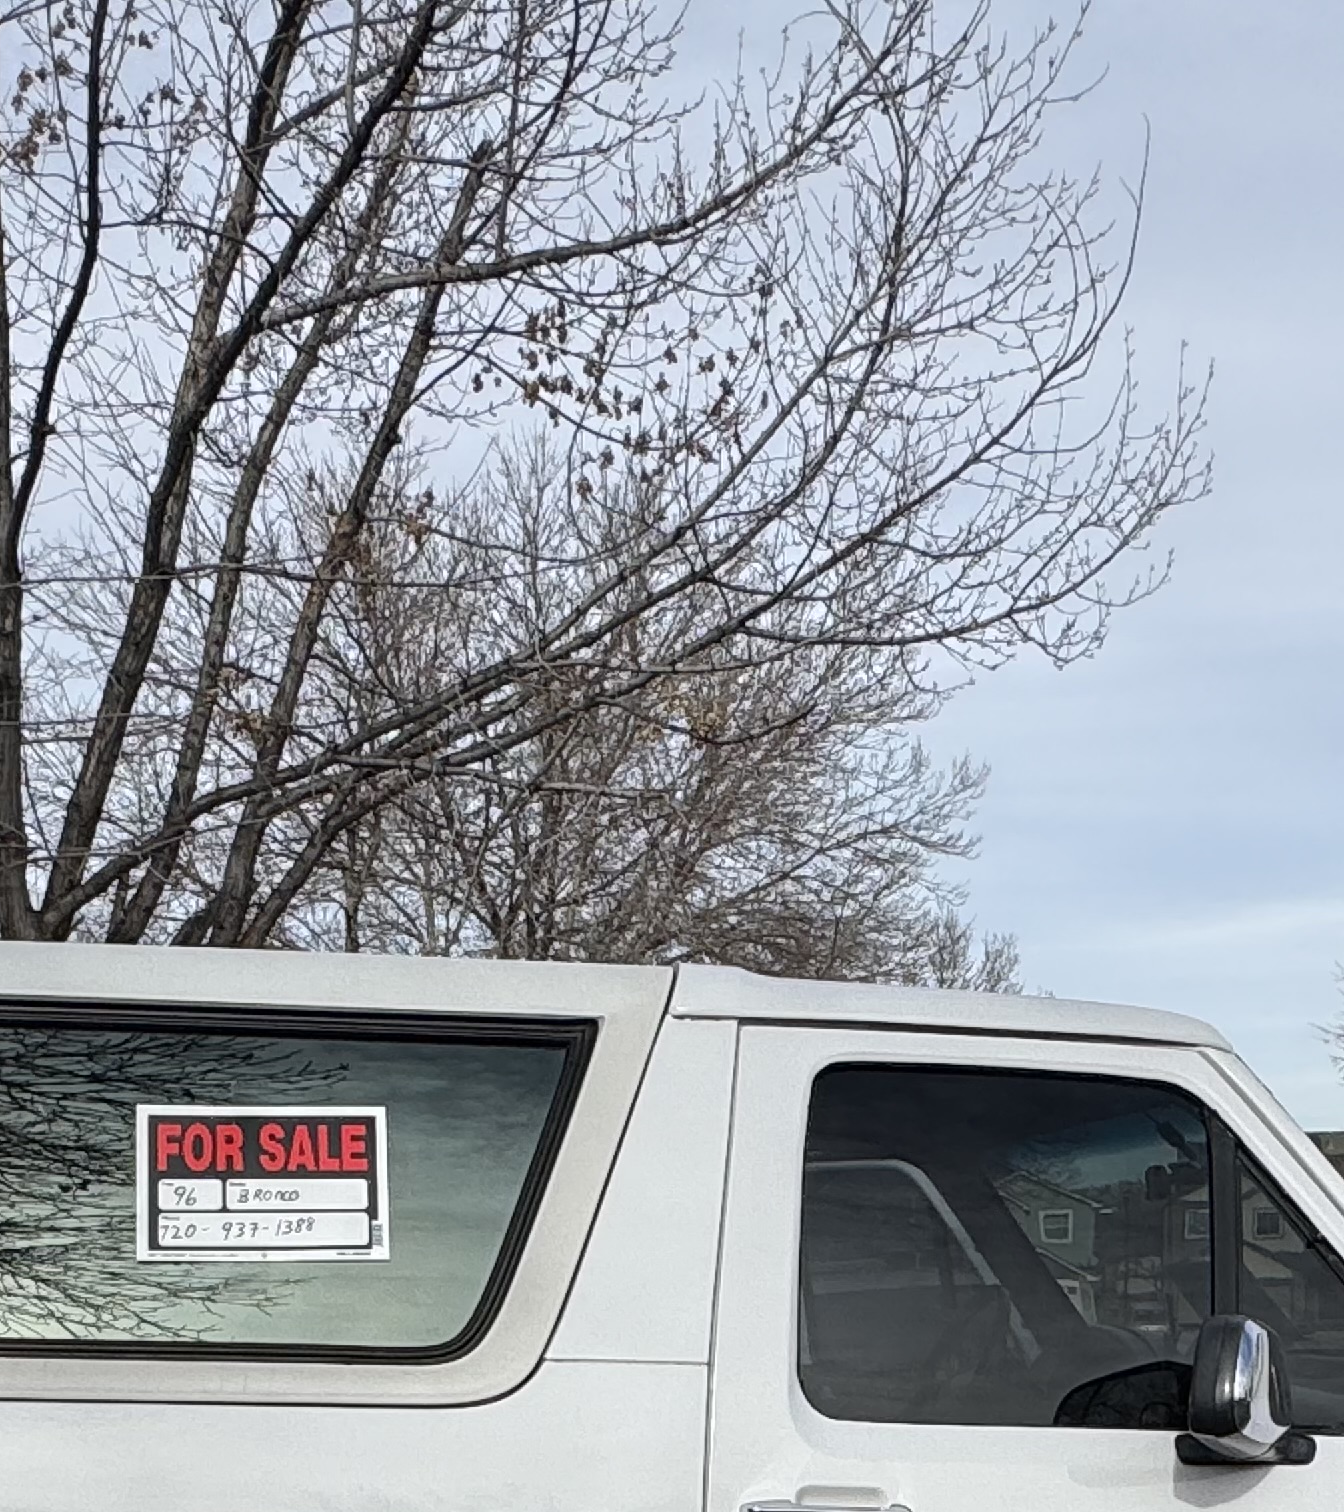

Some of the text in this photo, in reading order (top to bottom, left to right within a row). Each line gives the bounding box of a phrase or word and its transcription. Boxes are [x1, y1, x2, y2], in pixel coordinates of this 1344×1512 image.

[157, 1122, 369, 1172] FOR SALE
[173, 1185, 197, 1206] 96
